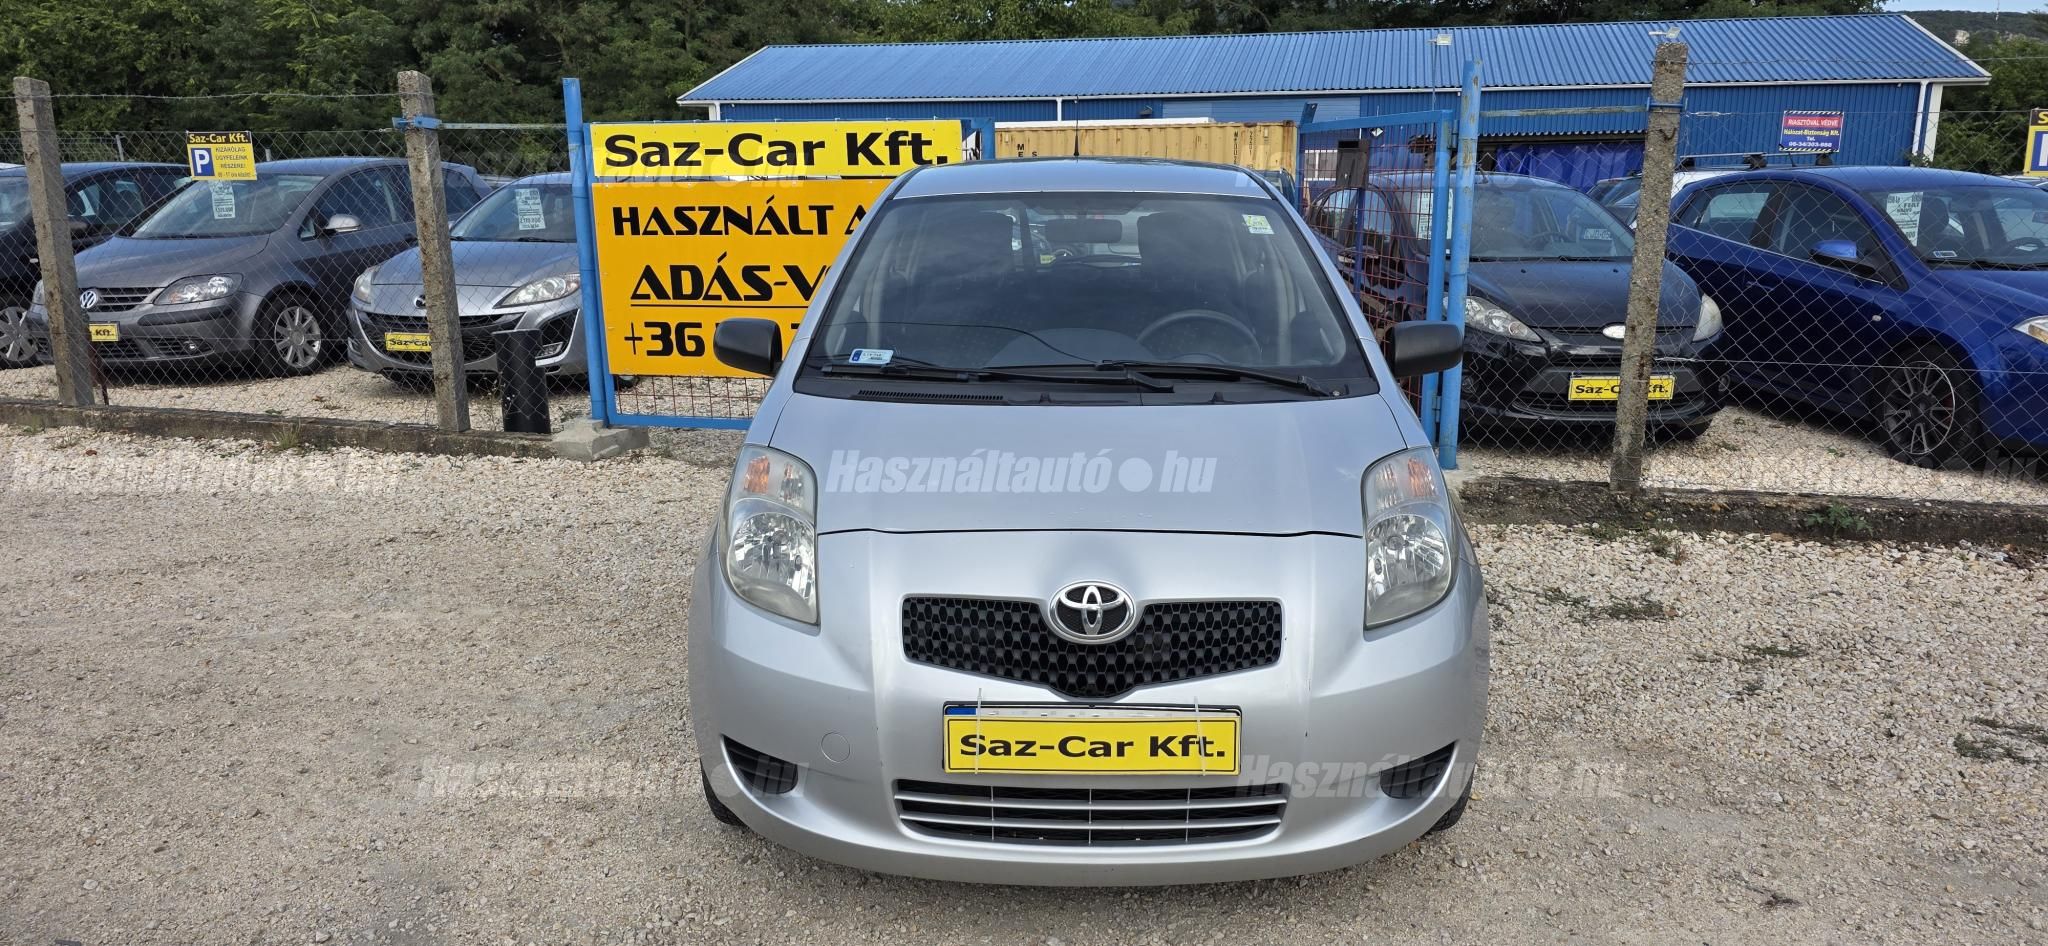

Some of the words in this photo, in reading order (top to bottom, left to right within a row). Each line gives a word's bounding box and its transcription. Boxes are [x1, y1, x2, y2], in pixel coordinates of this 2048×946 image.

[189, 133, 227, 143] Saz-Car
[228, 132, 249, 143] Kft.
[604, 133, 825, 167] Saz-Car
[846, 130, 949, 166] Kft.
[612, 195, 834, 236] HASZNÁLT
[630, 251, 830, 301] ADÁS-V
[624, 321, 705, 357] +36
[960, 734, 1134, 758] Saz-Car
[1148, 734, 1226, 758] Kft.
